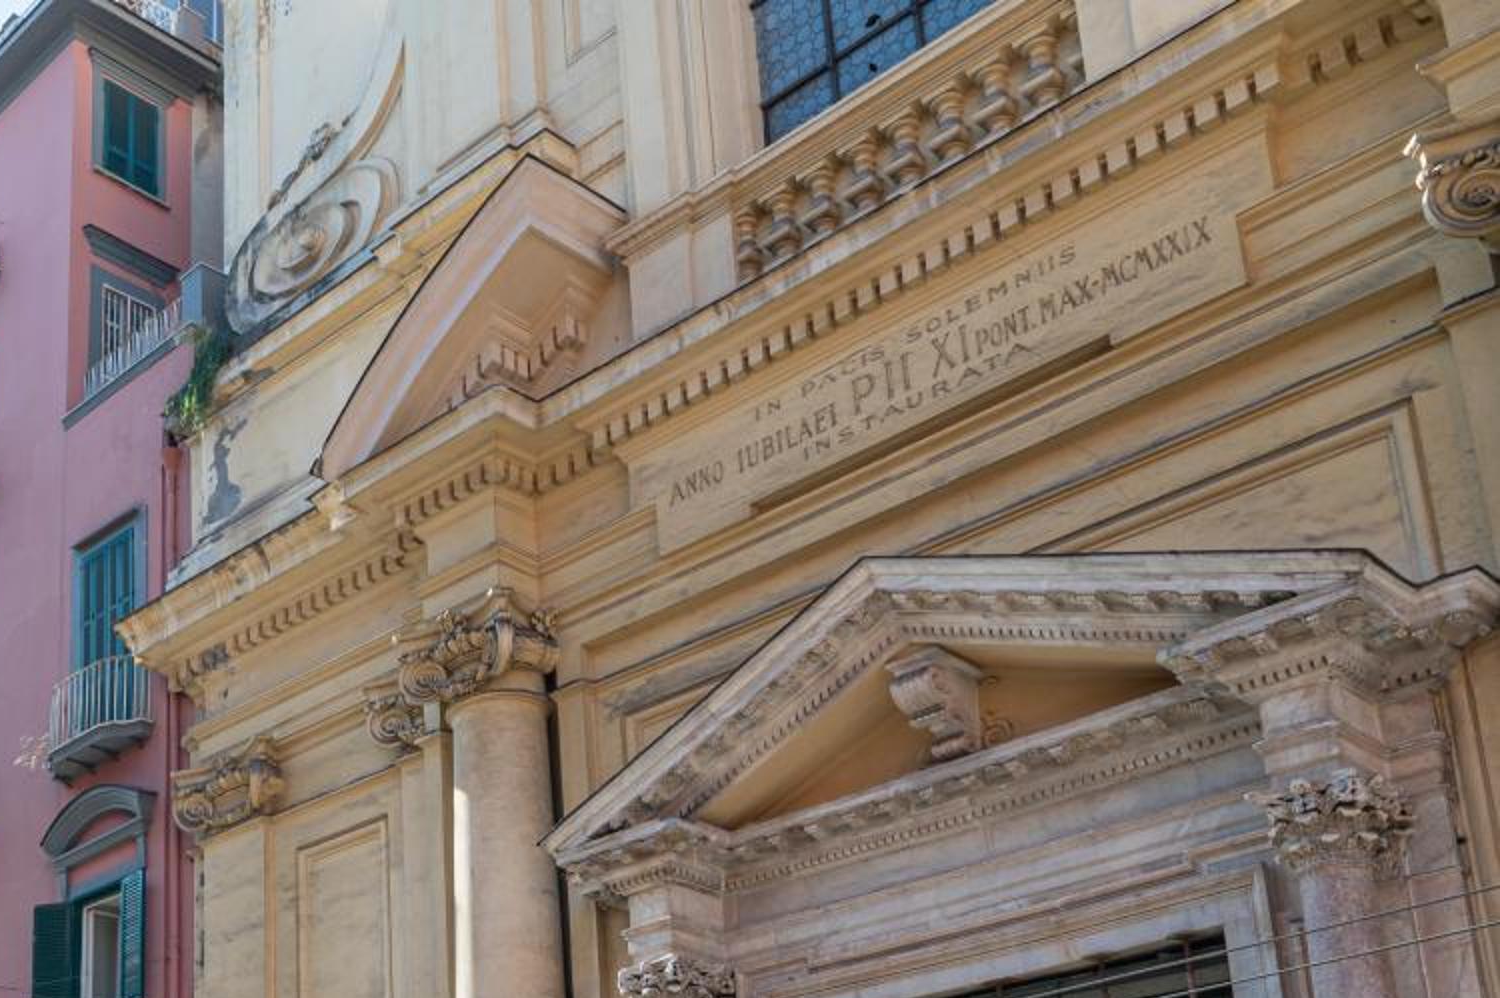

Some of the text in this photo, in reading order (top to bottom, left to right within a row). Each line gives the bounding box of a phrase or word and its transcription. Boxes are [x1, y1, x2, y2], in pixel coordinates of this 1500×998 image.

[669, 460, 725, 507] ANNO
[736, 402, 838, 474] IUBILAEI
[851, 351, 915, 416] PII
[931, 323, 971, 379] XI
[755, 243, 1077, 421] IN PACIS SOLEMNIIS
[803, 342, 1043, 461] INSTAURATA
